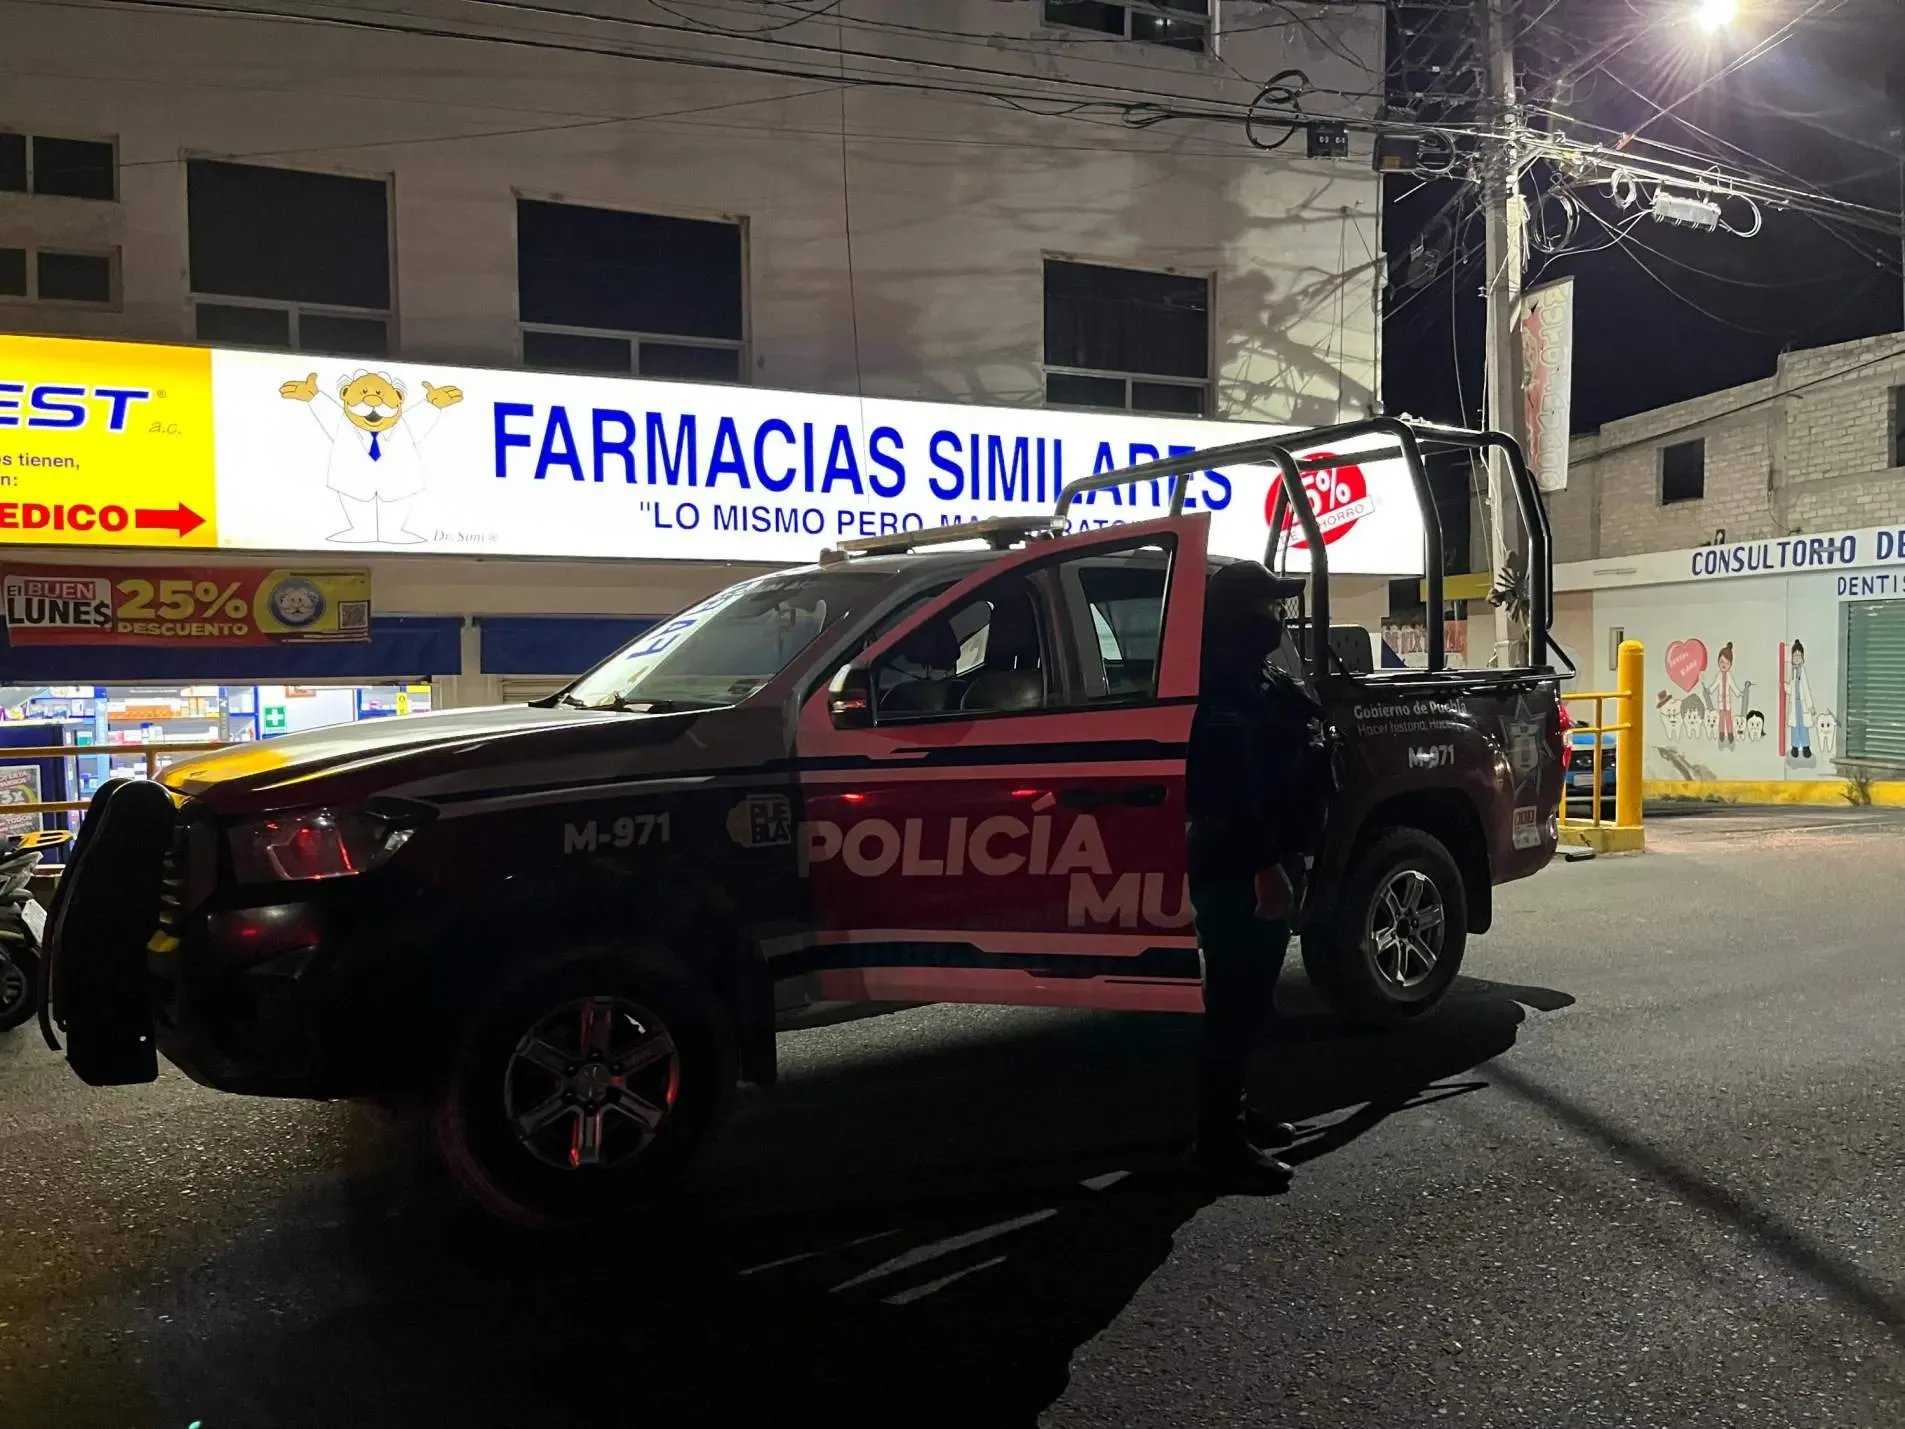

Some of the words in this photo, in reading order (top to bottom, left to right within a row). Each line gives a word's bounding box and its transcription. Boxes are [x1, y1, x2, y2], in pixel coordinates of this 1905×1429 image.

[18, 452, 80, 470] tienen,
[493, 401, 907, 500] FARMACIAS
[928, 428, 1232, 511] SIMILARES
[713, 504, 825, 535] MISMO
[837, 510, 923, 536] PERO
[1691, 535, 1857, 577] CONSULTORIO
[27, 582, 94, 600] BUEN
[116, 579, 248, 620] 25%
[117, 622, 249, 636] DESCUENTO
[1353, 702, 1411, 719] Gobierno
[1413, 700, 1428, 715] de
[1408, 743, 1455, 769] M-971
[563, 812, 671, 855] M-971
[797, 791, 1113, 878] POLICÍA
